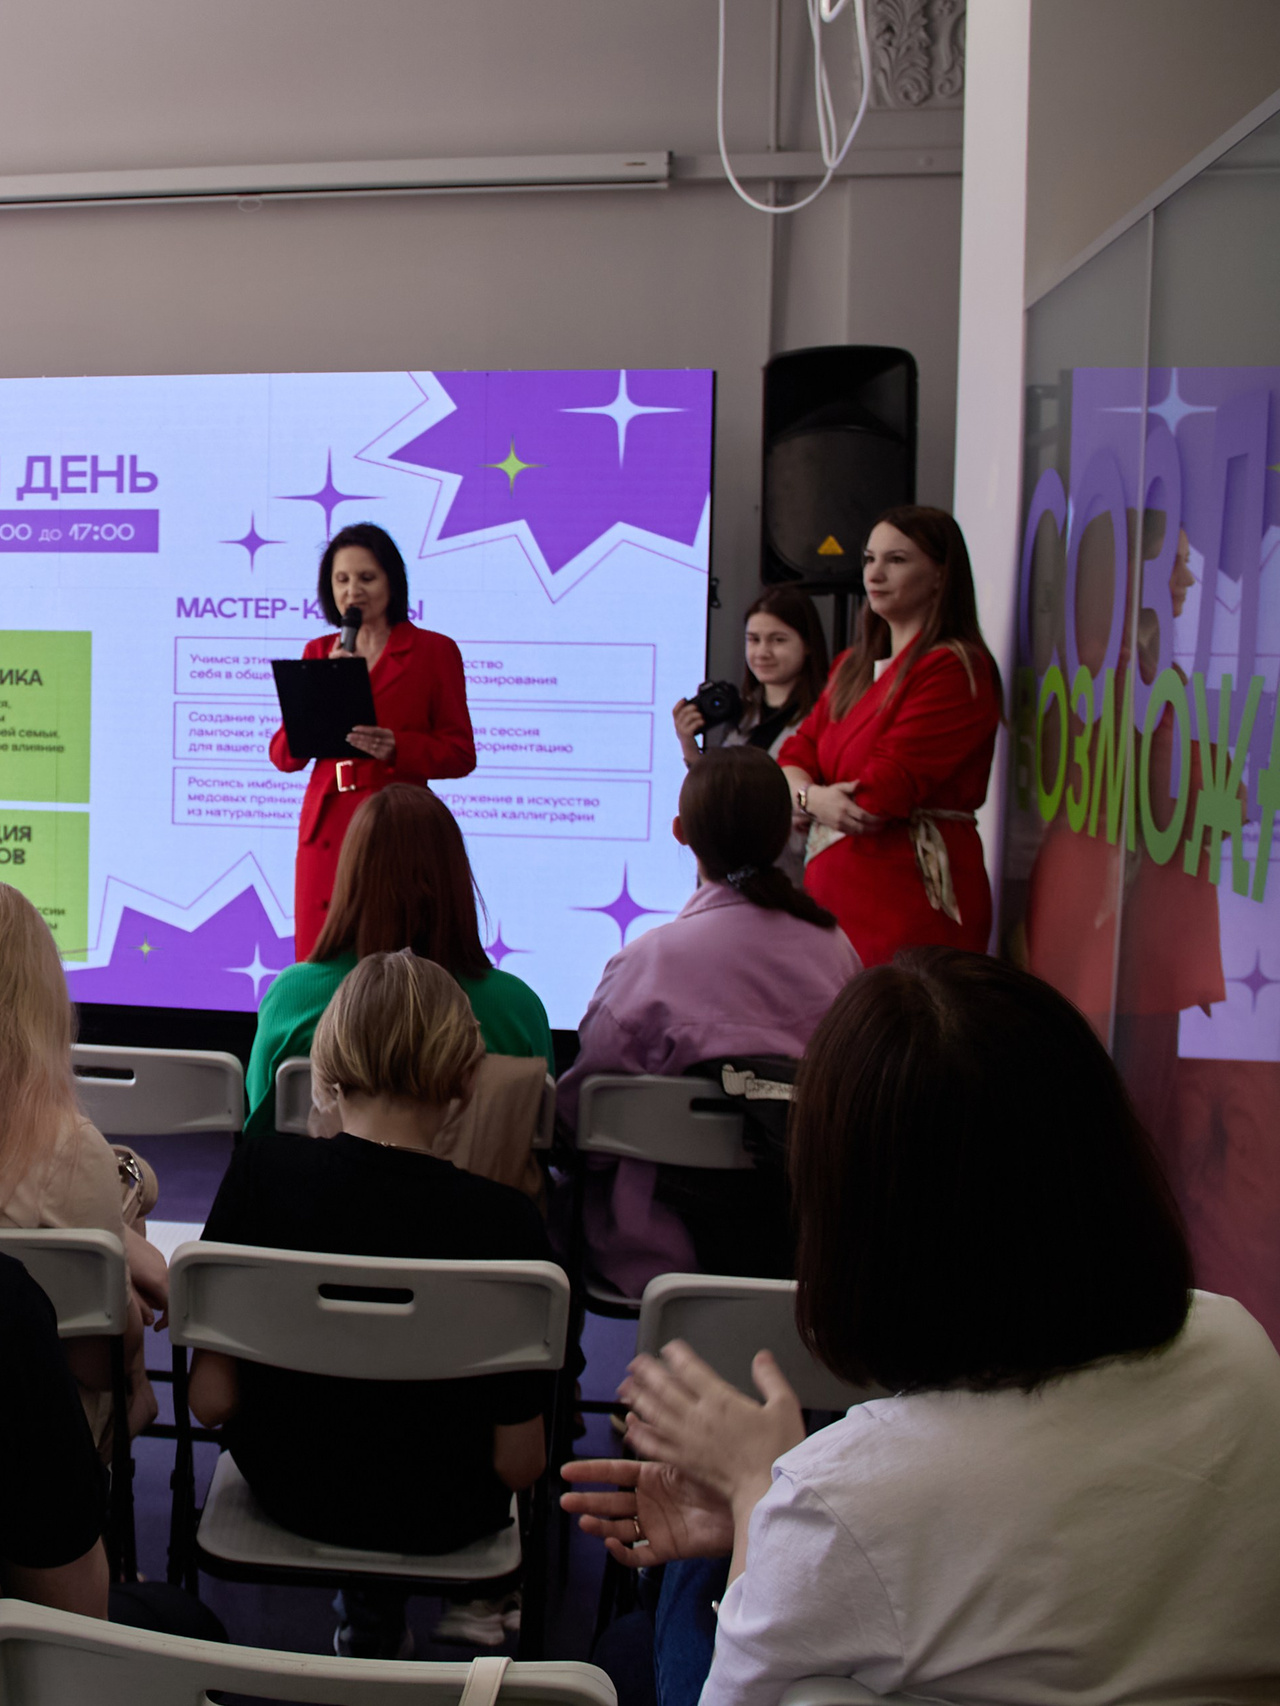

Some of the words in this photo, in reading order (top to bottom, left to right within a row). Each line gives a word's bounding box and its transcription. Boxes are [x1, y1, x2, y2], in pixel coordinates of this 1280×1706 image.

[17, 455, 158, 501] ДЕНЬ
[38, 529, 63, 542] до
[69, 523, 135, 541] 17:00
[190, 654, 239, 664] Учимся
[190, 668, 221, 679] себя
[189, 711, 255, 723] Создание
[189, 728, 254, 738] лампочки
[490, 727, 540, 736] сессия
[11, 743, 65, 754] влияние
[188, 743, 213, 752] для
[216, 744, 265, 753] вашего
[188, 777, 244, 788] Роспись
[188, 793, 246, 803] медовых
[527, 797, 600, 808] искусство
[188, 808, 202, 816] из
[206, 809, 293, 819] натуральных
[501, 811, 594, 822] каллиграфии
